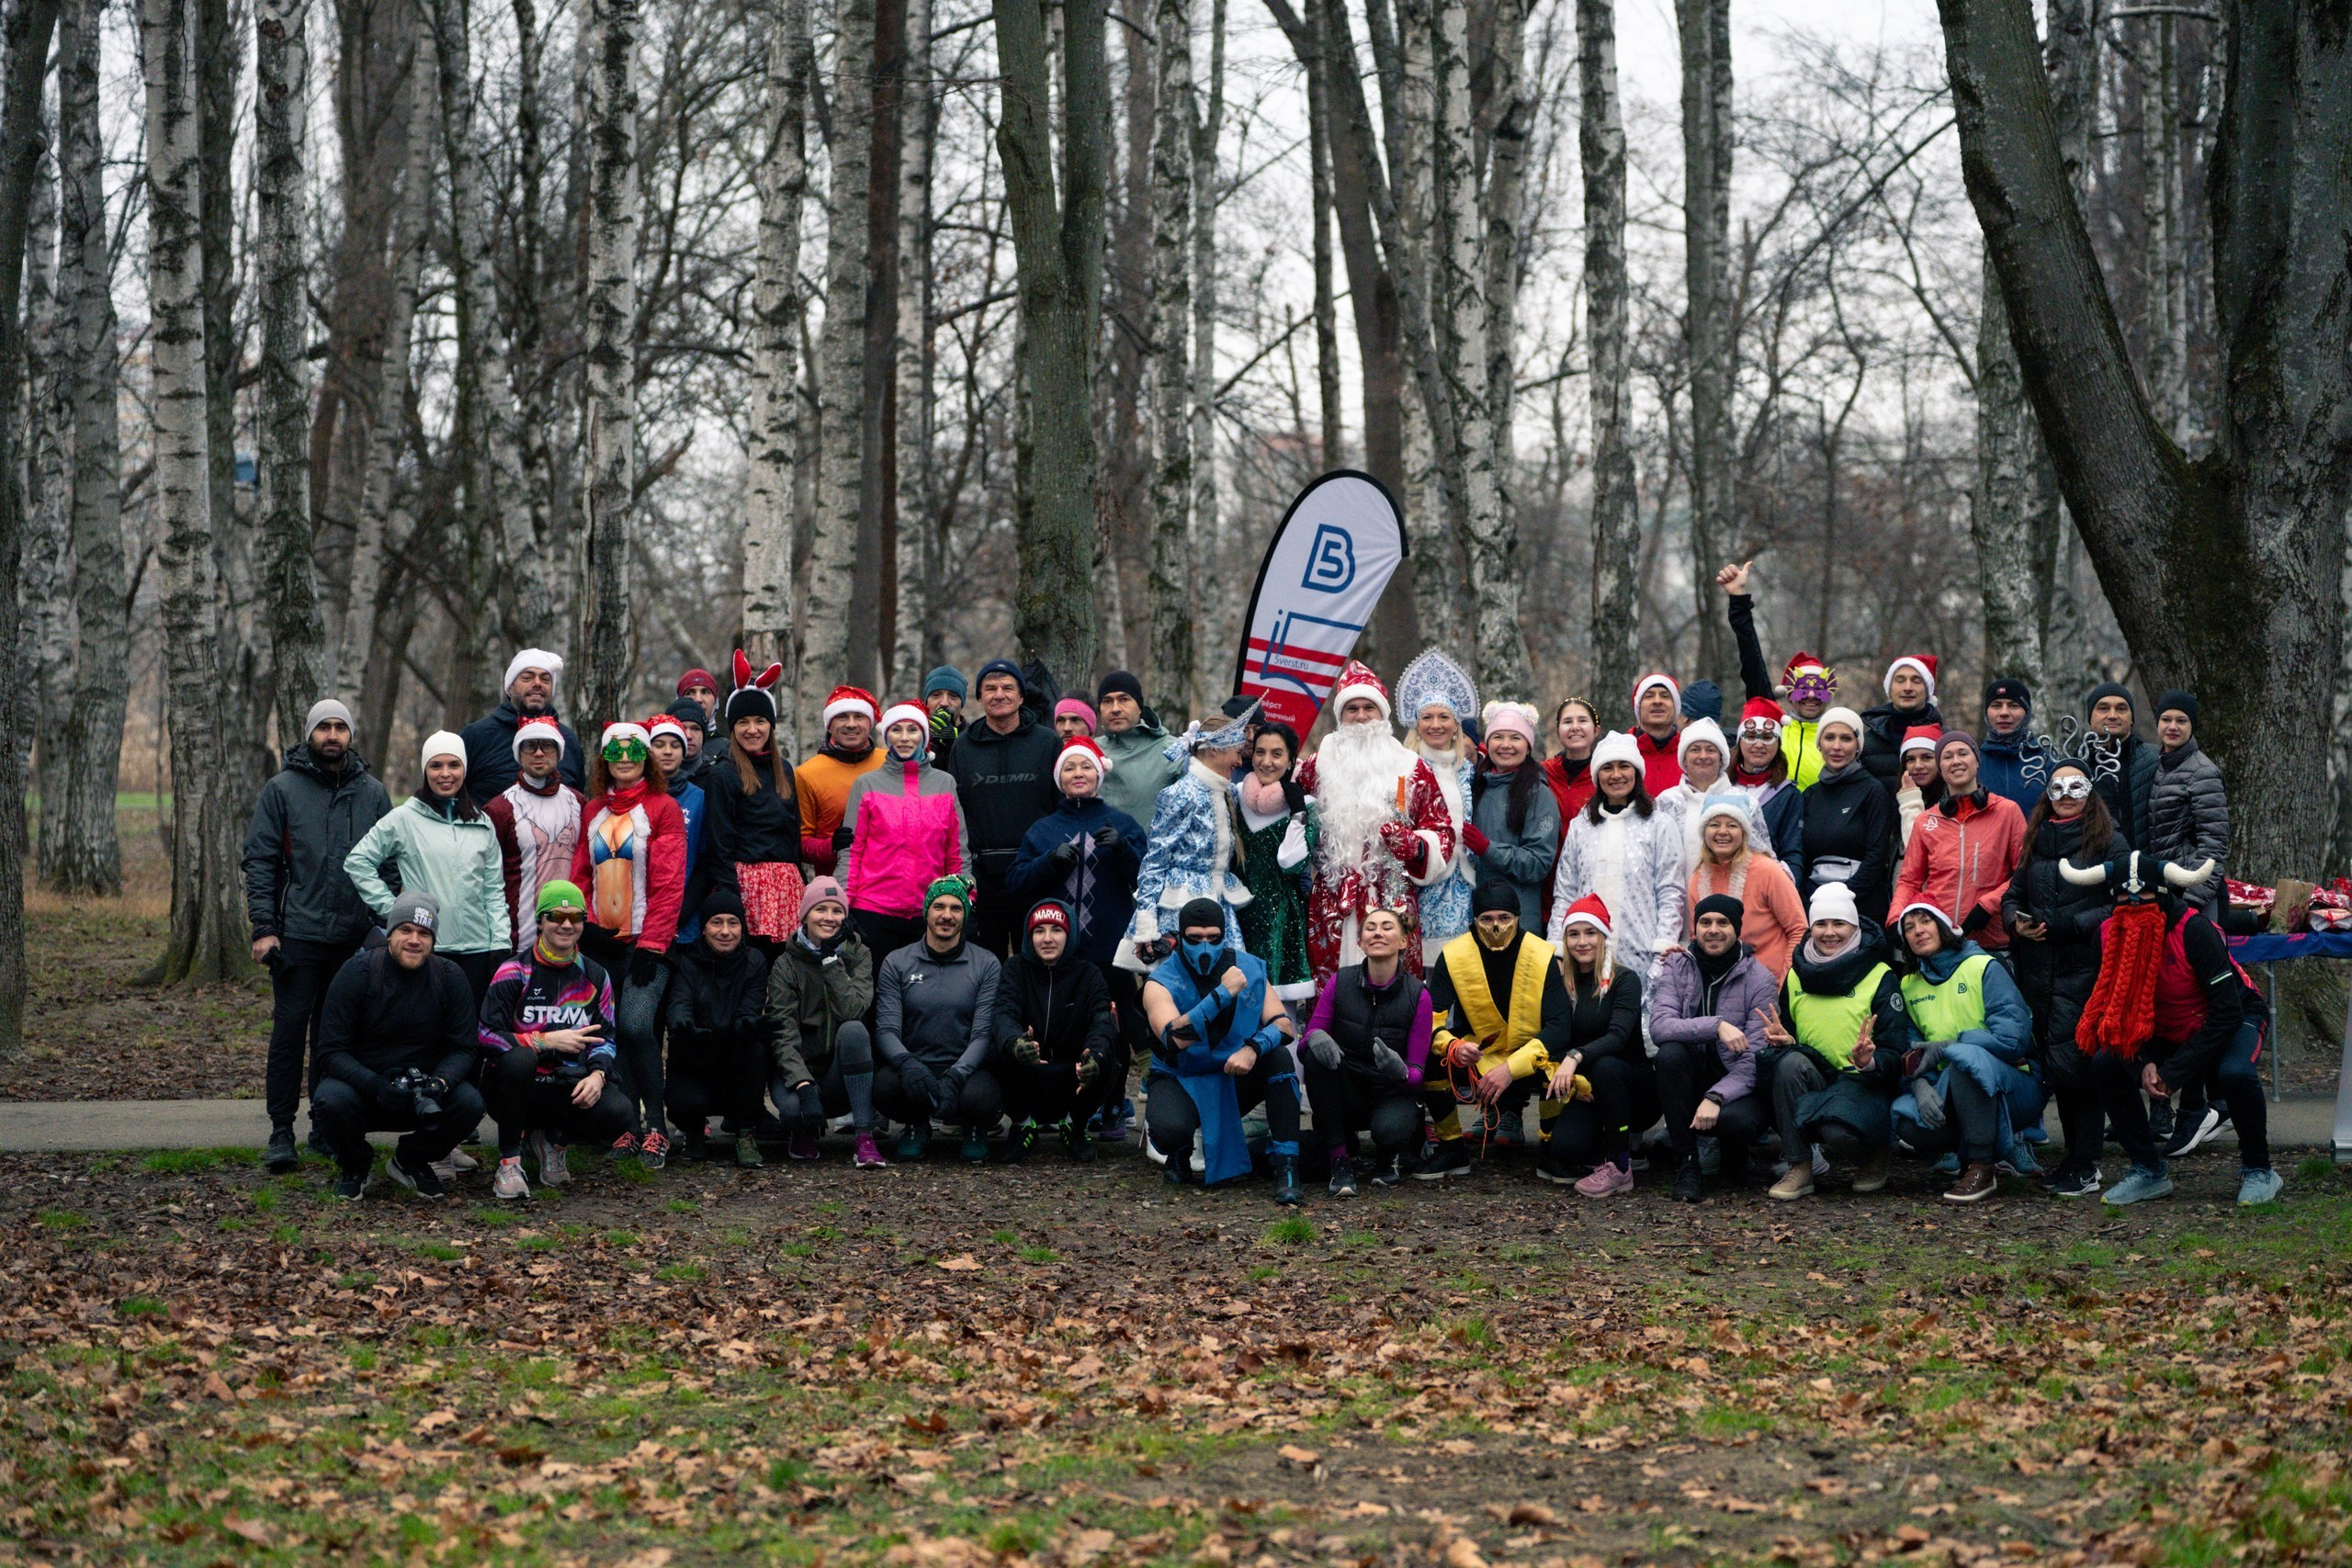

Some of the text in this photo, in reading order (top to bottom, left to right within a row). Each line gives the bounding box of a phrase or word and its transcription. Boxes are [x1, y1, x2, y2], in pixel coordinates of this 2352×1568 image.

[1274, 655, 1309, 671] 5verst.ru
[985, 773, 1039, 784] DEMIX
[415, 907, 429, 917] IRON
[1035, 909, 1064, 923] MARVEL
[413, 913, 433, 928] STAR
[522, 1005, 590, 1026] STRAVA
